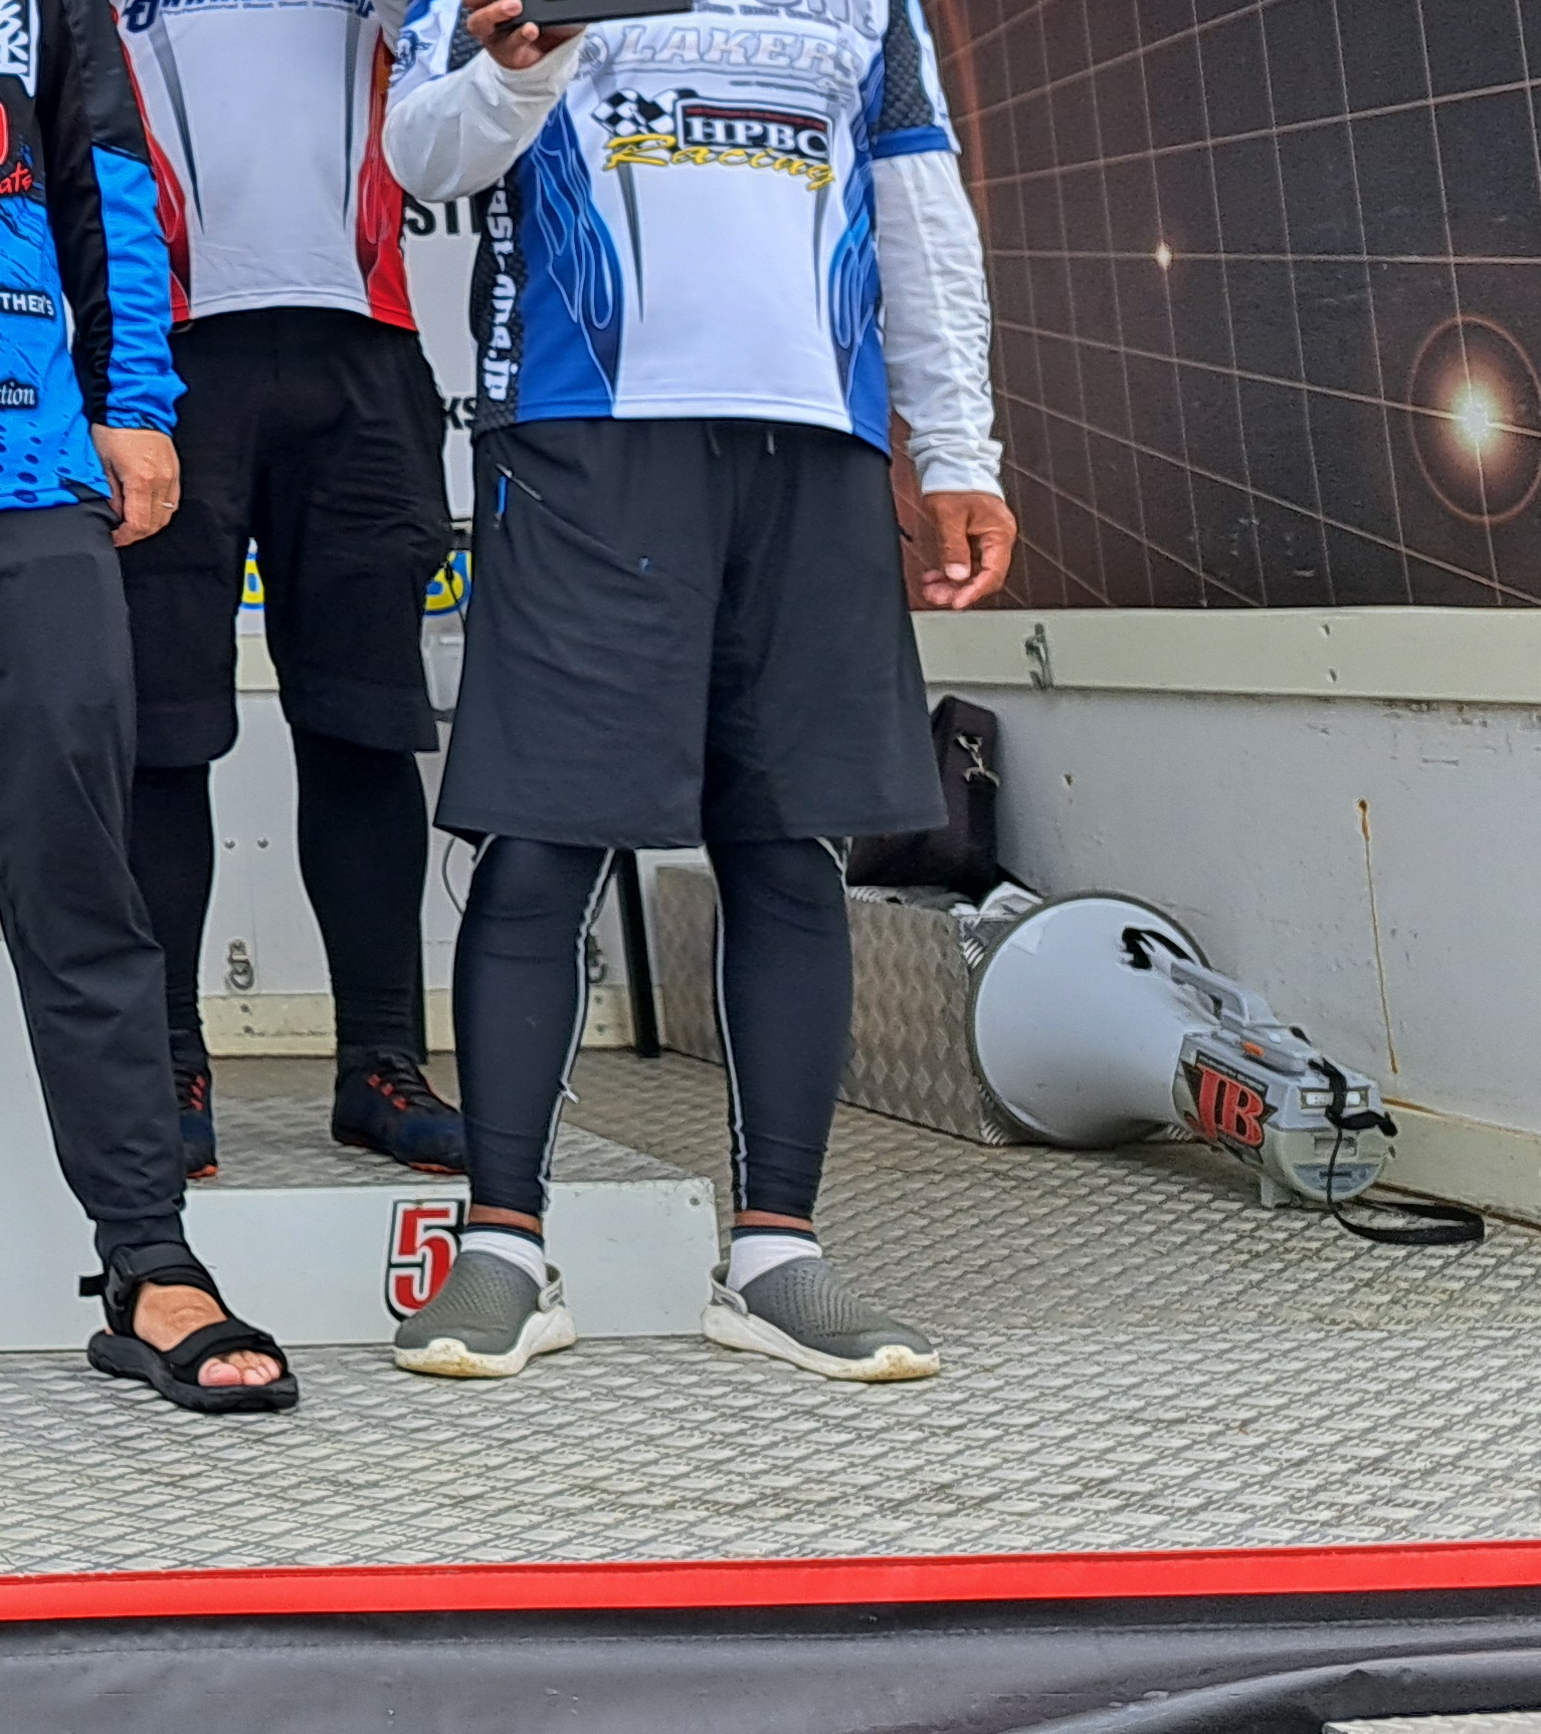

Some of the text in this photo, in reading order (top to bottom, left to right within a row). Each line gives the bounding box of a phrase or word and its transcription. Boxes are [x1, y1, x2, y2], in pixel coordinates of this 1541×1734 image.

[604, 132, 835, 191] Racing
[687, 116, 830, 160] HPBC
[1185, 1062, 1266, 1150] JB
[385, 1198, 468, 1322] 5
